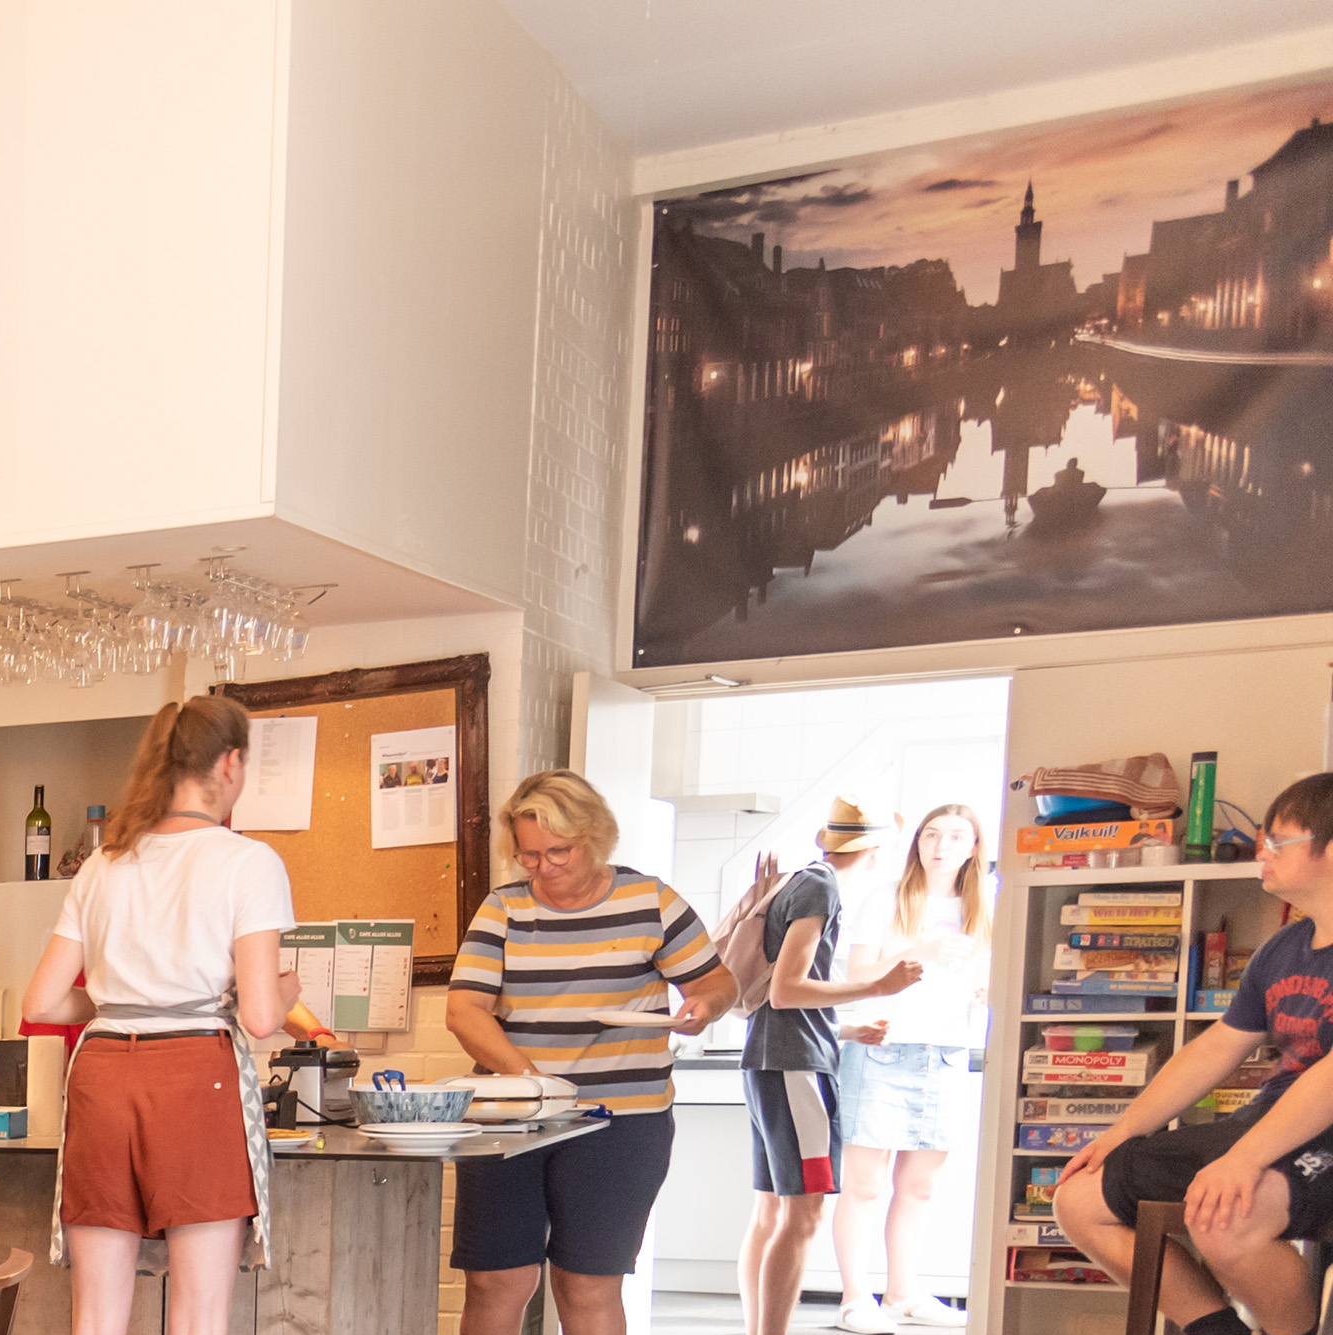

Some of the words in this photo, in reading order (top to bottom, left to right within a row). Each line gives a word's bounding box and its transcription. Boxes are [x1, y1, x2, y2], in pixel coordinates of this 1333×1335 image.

[1053, 825, 1120, 840] Valkuil!
[1123, 936, 1175, 948] STRATEGO
[1054, 1056, 1123, 1066] MONOPOLY
[1058, 1074, 1109, 1083] MONPOLY
